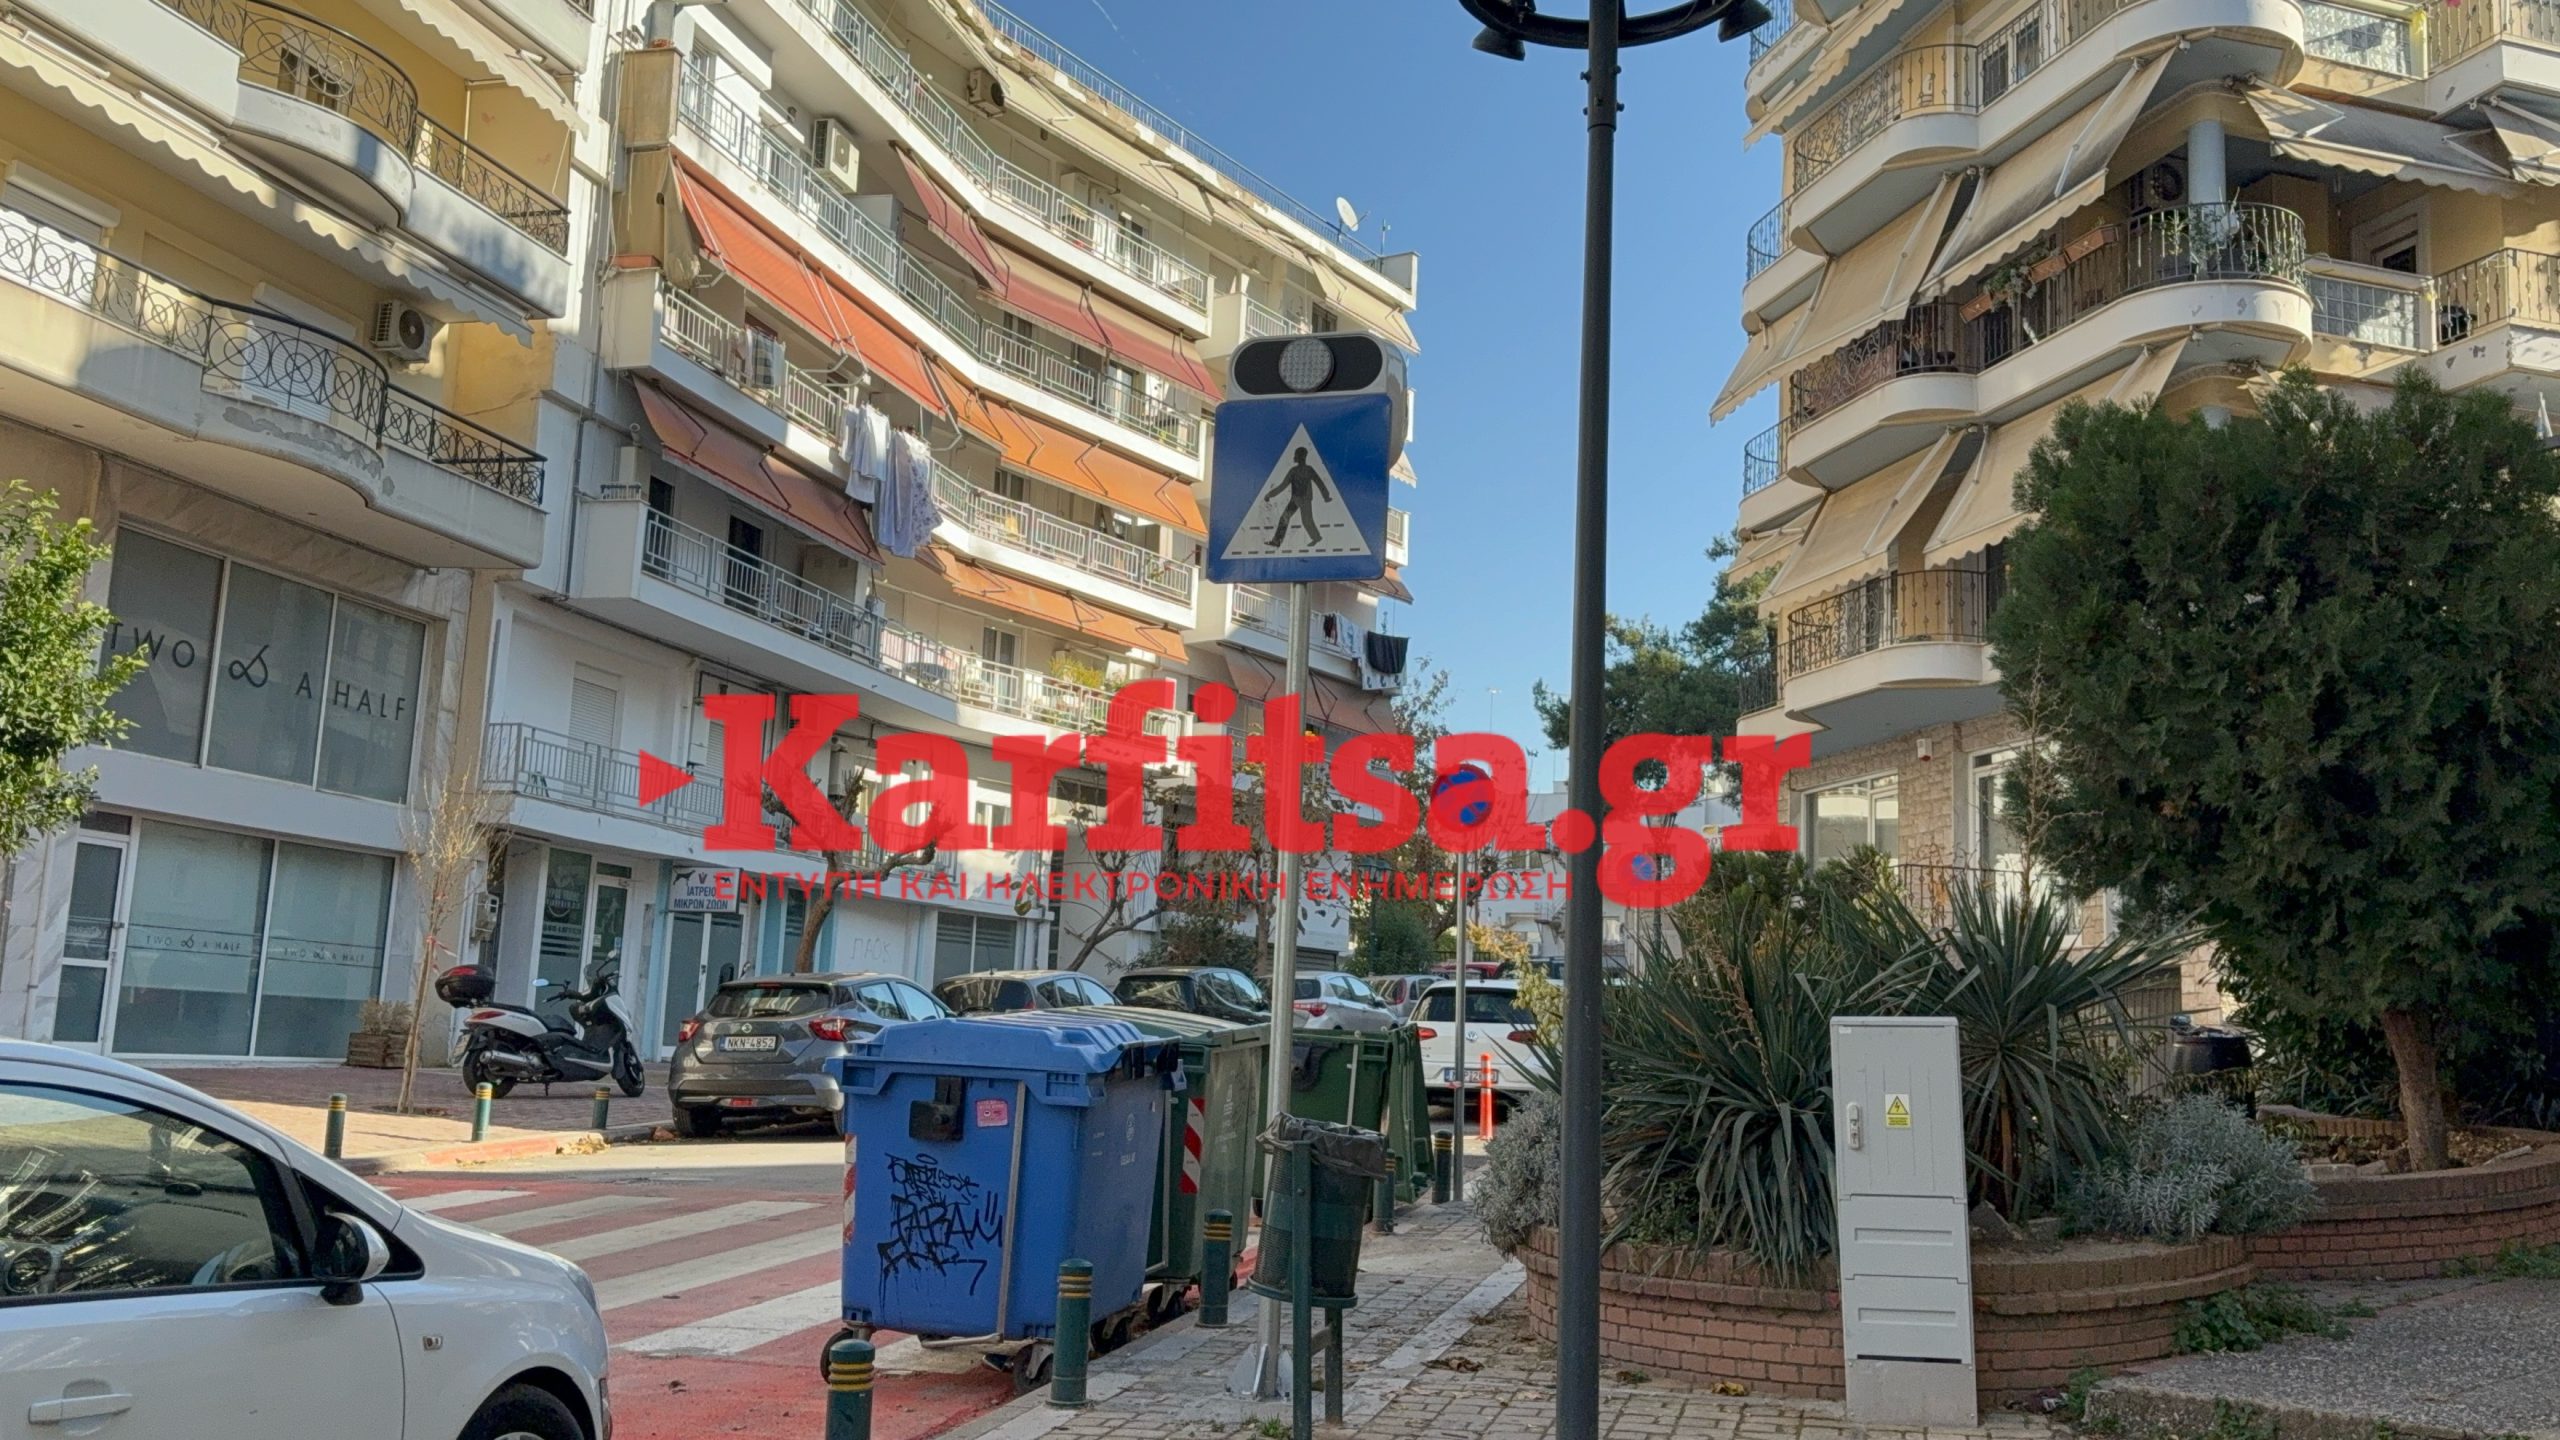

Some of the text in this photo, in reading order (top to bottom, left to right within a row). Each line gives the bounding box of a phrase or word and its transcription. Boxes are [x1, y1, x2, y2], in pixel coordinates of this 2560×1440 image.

[109, 622, 196, 668] TWO
[296, 671, 312, 699] A
[333, 680, 406, 720] HALF
[686, 886, 717, 897] ΙΑΤΡΕΙΟ
[674, 898, 704, 909] ΜΙΚΡΩΝ
[146, 935, 172, 946] TWO
[215, 942, 241, 952] HALF
